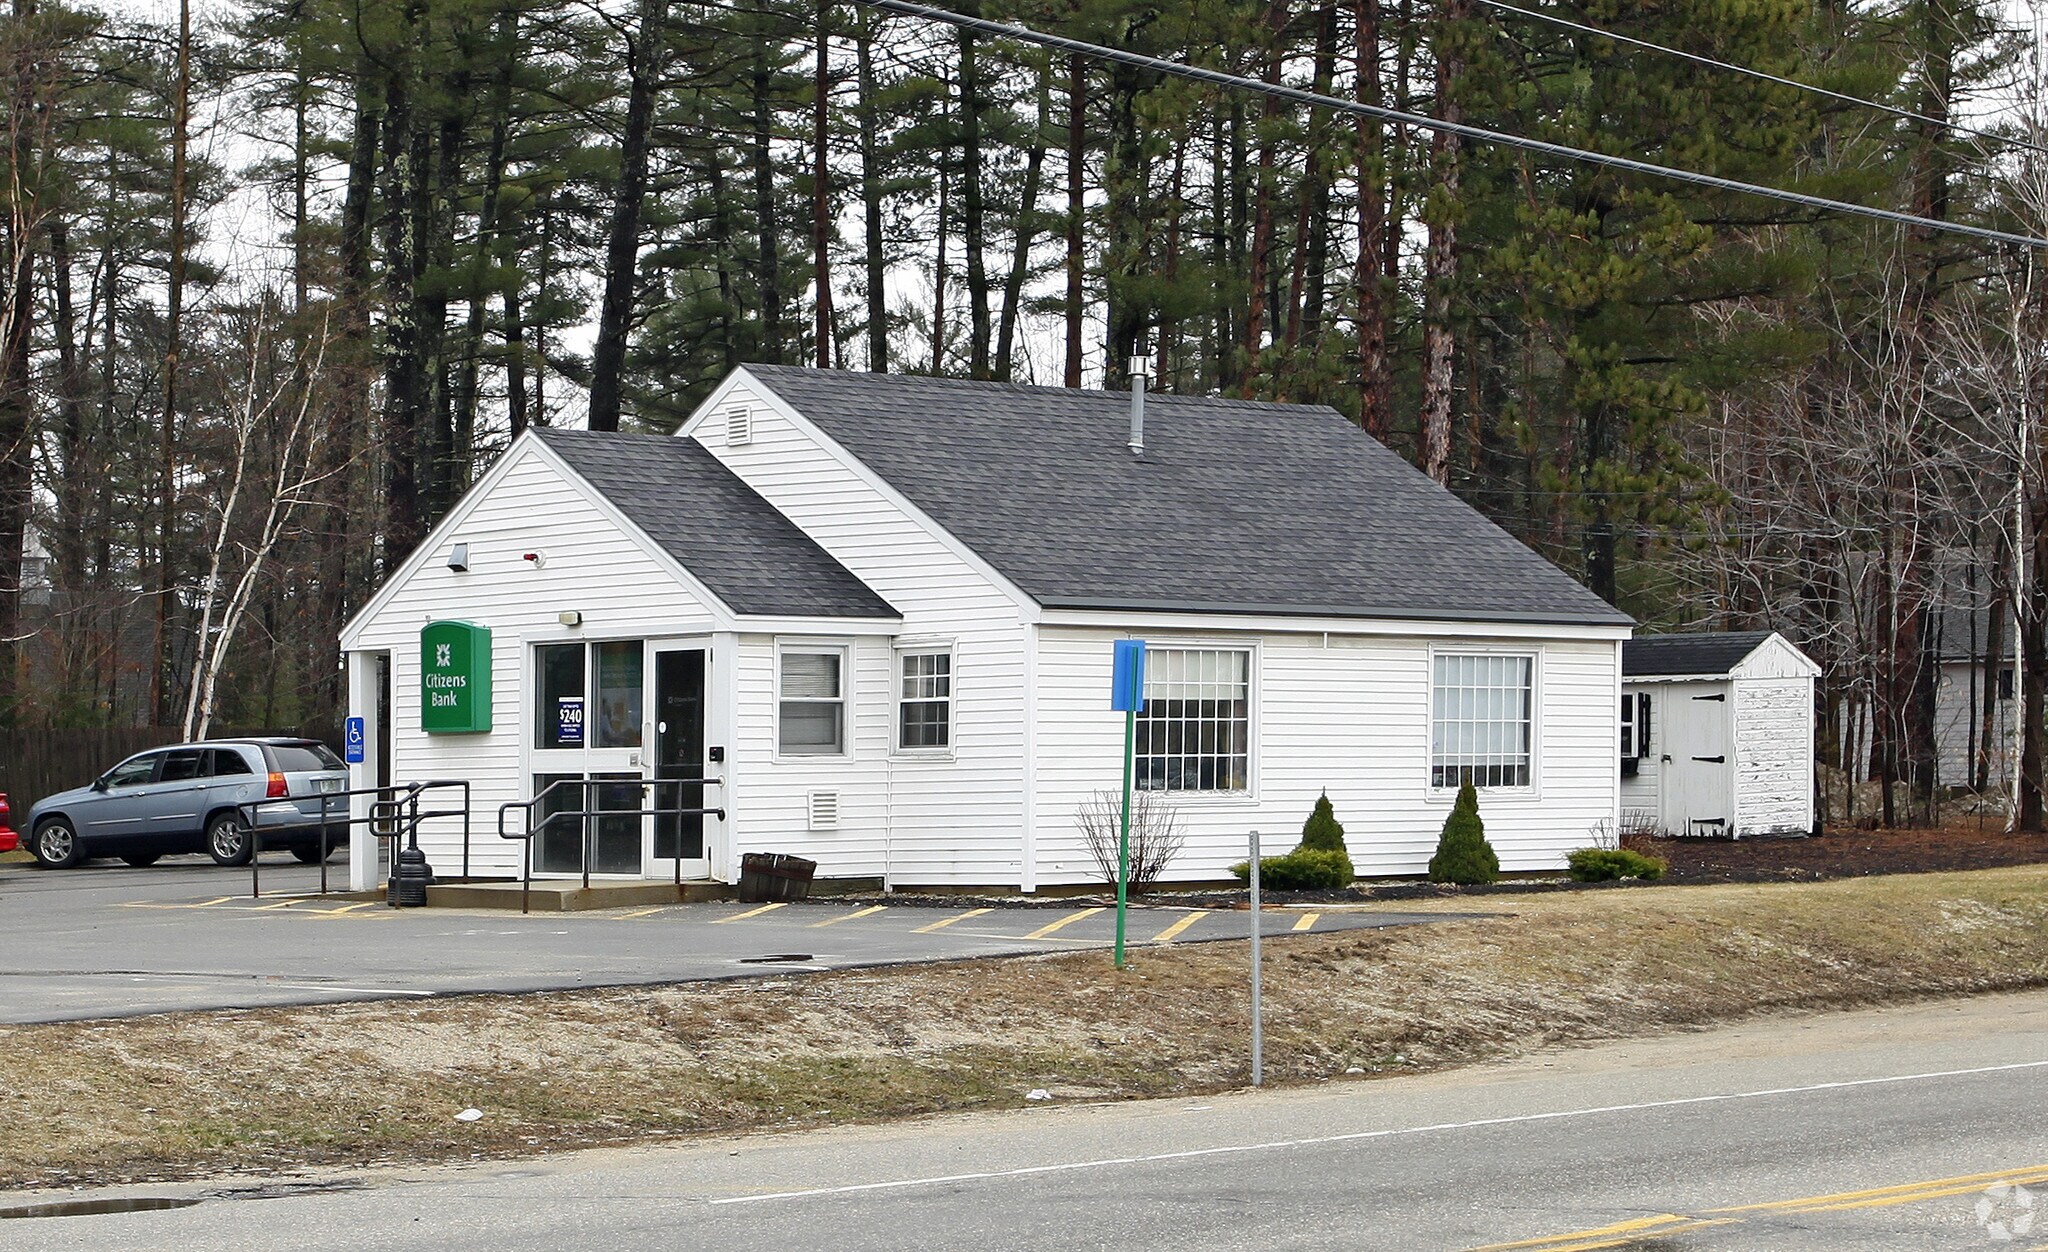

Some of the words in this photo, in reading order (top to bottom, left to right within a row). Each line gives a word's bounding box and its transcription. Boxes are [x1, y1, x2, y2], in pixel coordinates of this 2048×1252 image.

[426, 673, 466, 688] Citizens
[431, 690, 457, 707] Bank
[559, 708, 582, 723] $240
